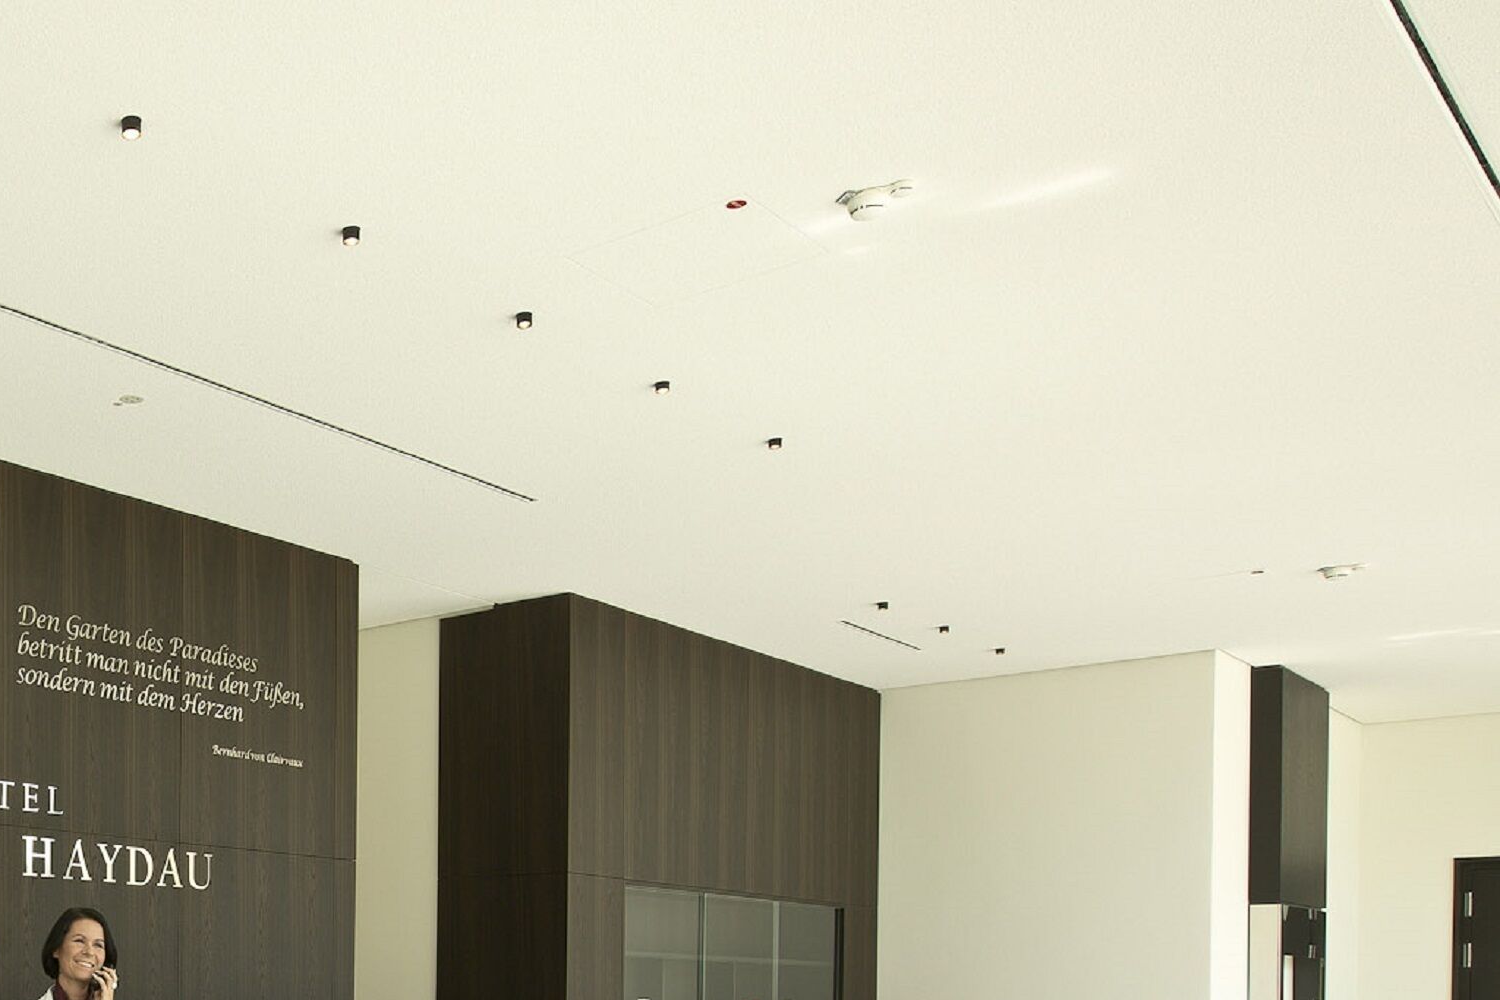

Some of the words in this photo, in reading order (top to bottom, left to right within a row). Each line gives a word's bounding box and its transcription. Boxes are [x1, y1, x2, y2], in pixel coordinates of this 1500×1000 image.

[17, 604, 61, 633] Den
[65, 614, 133, 647] Garten
[135, 627, 164, 653] des
[169, 636, 259, 673] Paradieses
[16, 667, 96, 697] sondern
[99, 680, 134, 703] mit
[137, 683, 176, 711] dem
[180, 692, 244, 722] Herzen
[17, 630, 83, 665] betritt
[85, 651, 130, 675] man
[132, 658, 181, 684] nicht
[184, 668, 216, 691] mit
[219, 671, 250, 697] den
[250, 680, 304, 710] Füßen,
[212, 744, 252, 760] Bernhard
[251, 753, 266, 763] von
[21, 834, 213, 890] HAYDAU
